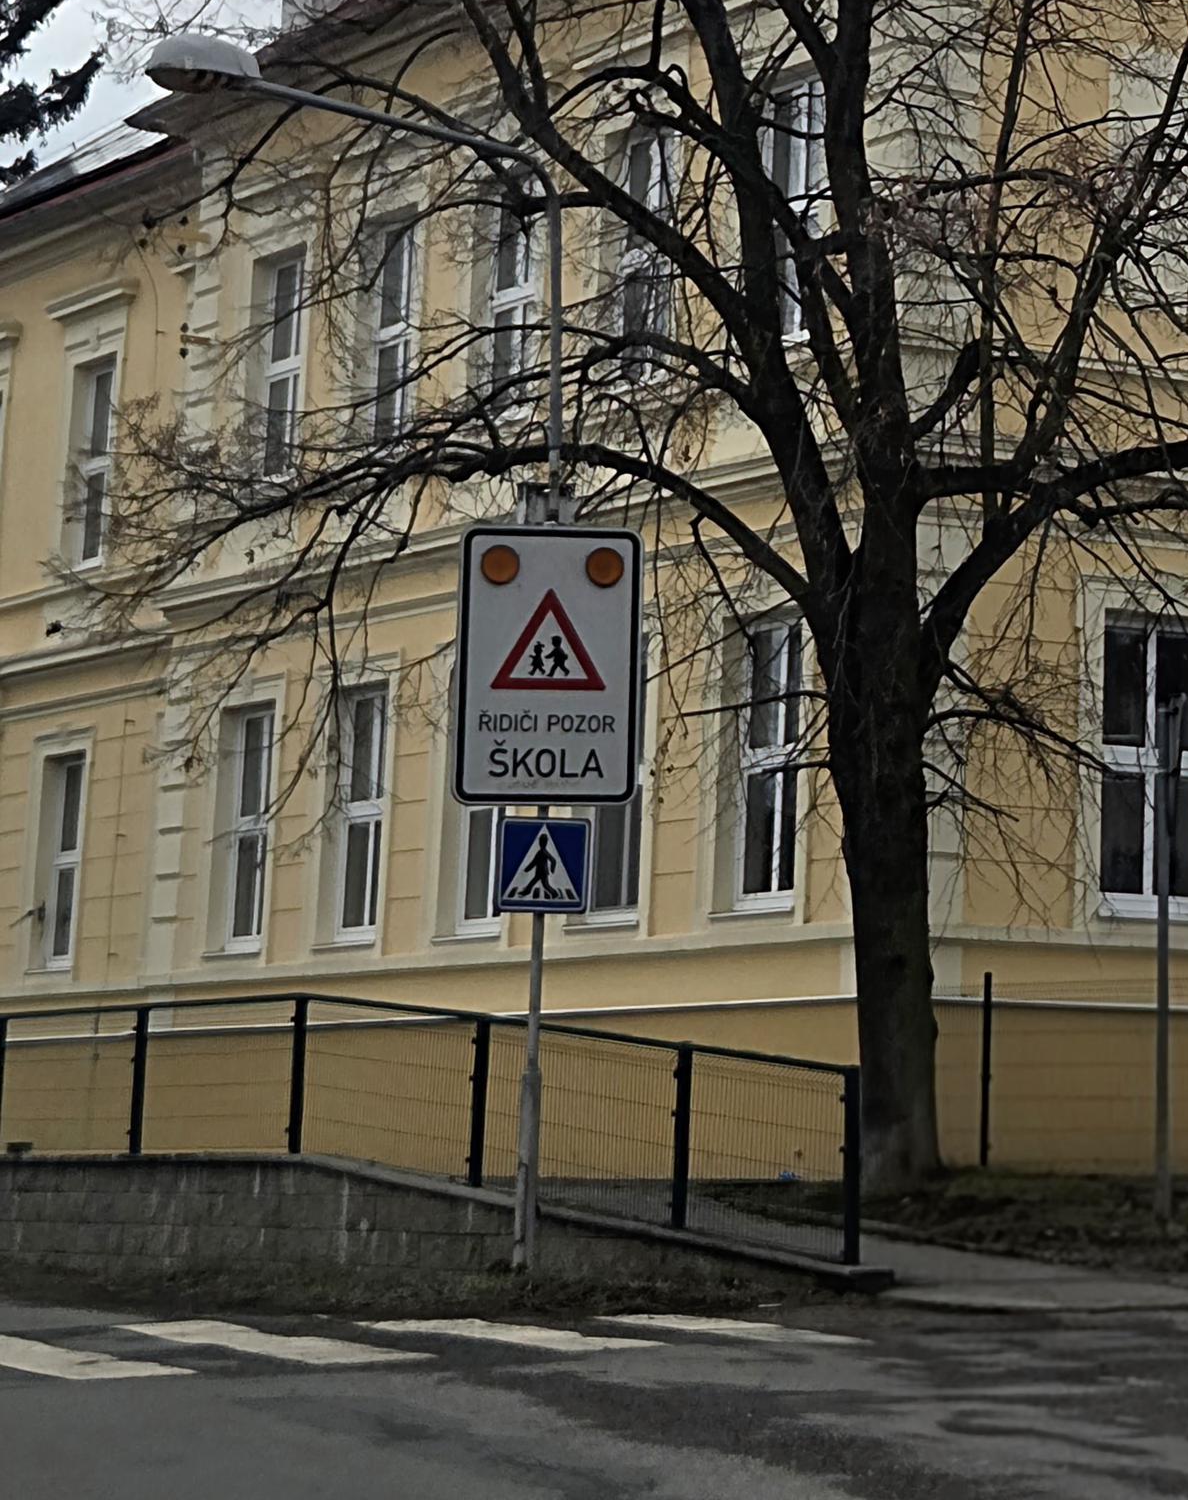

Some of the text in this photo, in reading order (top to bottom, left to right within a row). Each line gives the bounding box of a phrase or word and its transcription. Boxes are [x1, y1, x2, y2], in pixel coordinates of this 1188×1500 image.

[478, 709, 616, 733] ŘIDIČI POZOR
[487, 739, 605, 779] ŠKOLA
